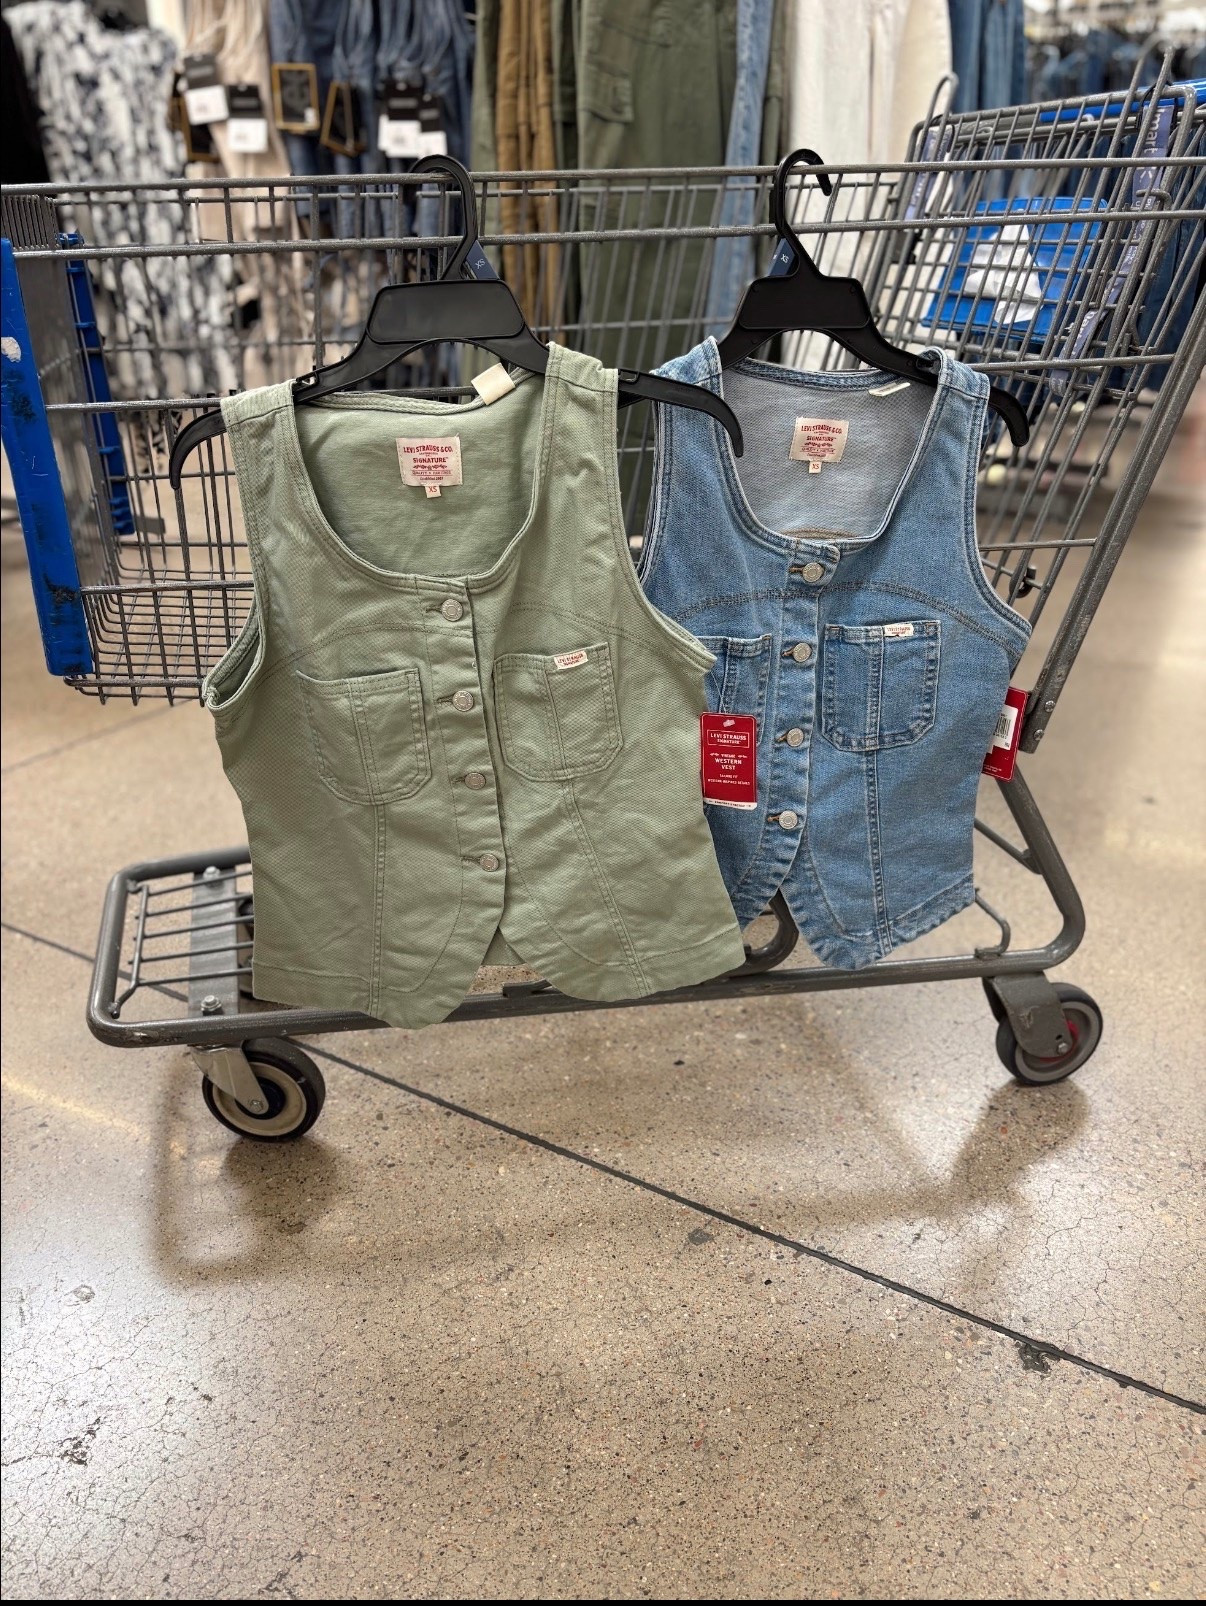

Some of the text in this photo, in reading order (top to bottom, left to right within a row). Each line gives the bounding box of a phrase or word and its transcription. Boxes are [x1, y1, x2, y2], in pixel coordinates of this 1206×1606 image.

[475, 258, 486, 270] XS
[812, 424, 831, 432] STRAUSS
[403, 446, 416, 454] LEVI
[415, 444, 440, 453] STRAUSS
[428, 485, 438, 493] XS
[722, 733, 747, 741] STRAUSS
[714, 757, 742, 765] WESTERN
